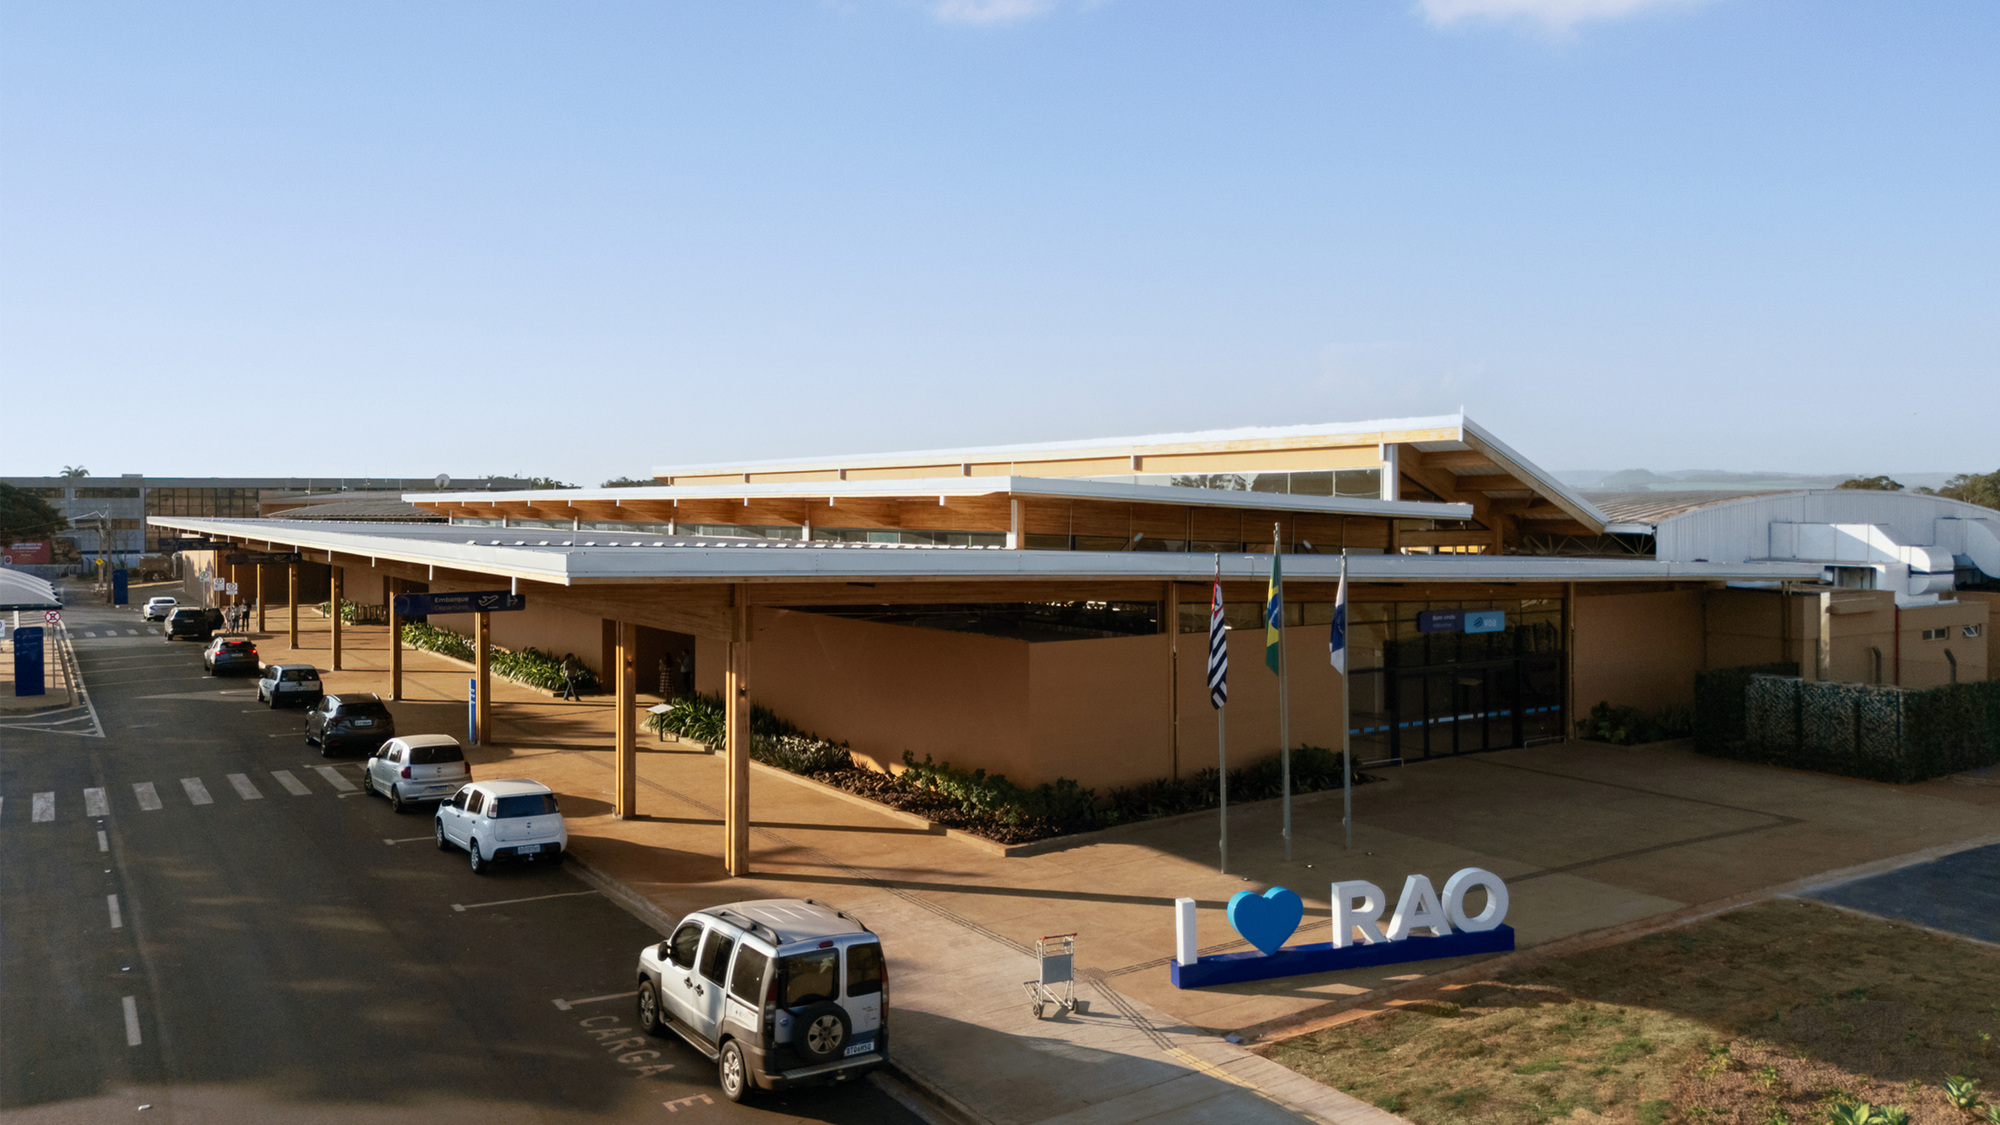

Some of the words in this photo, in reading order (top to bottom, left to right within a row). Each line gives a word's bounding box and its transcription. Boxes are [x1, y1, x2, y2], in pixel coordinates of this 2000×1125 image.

[1331, 867, 1510, 949] RAO
[579, 1015, 676, 1079] CARGA
[662, 1093, 715, 1113] E
